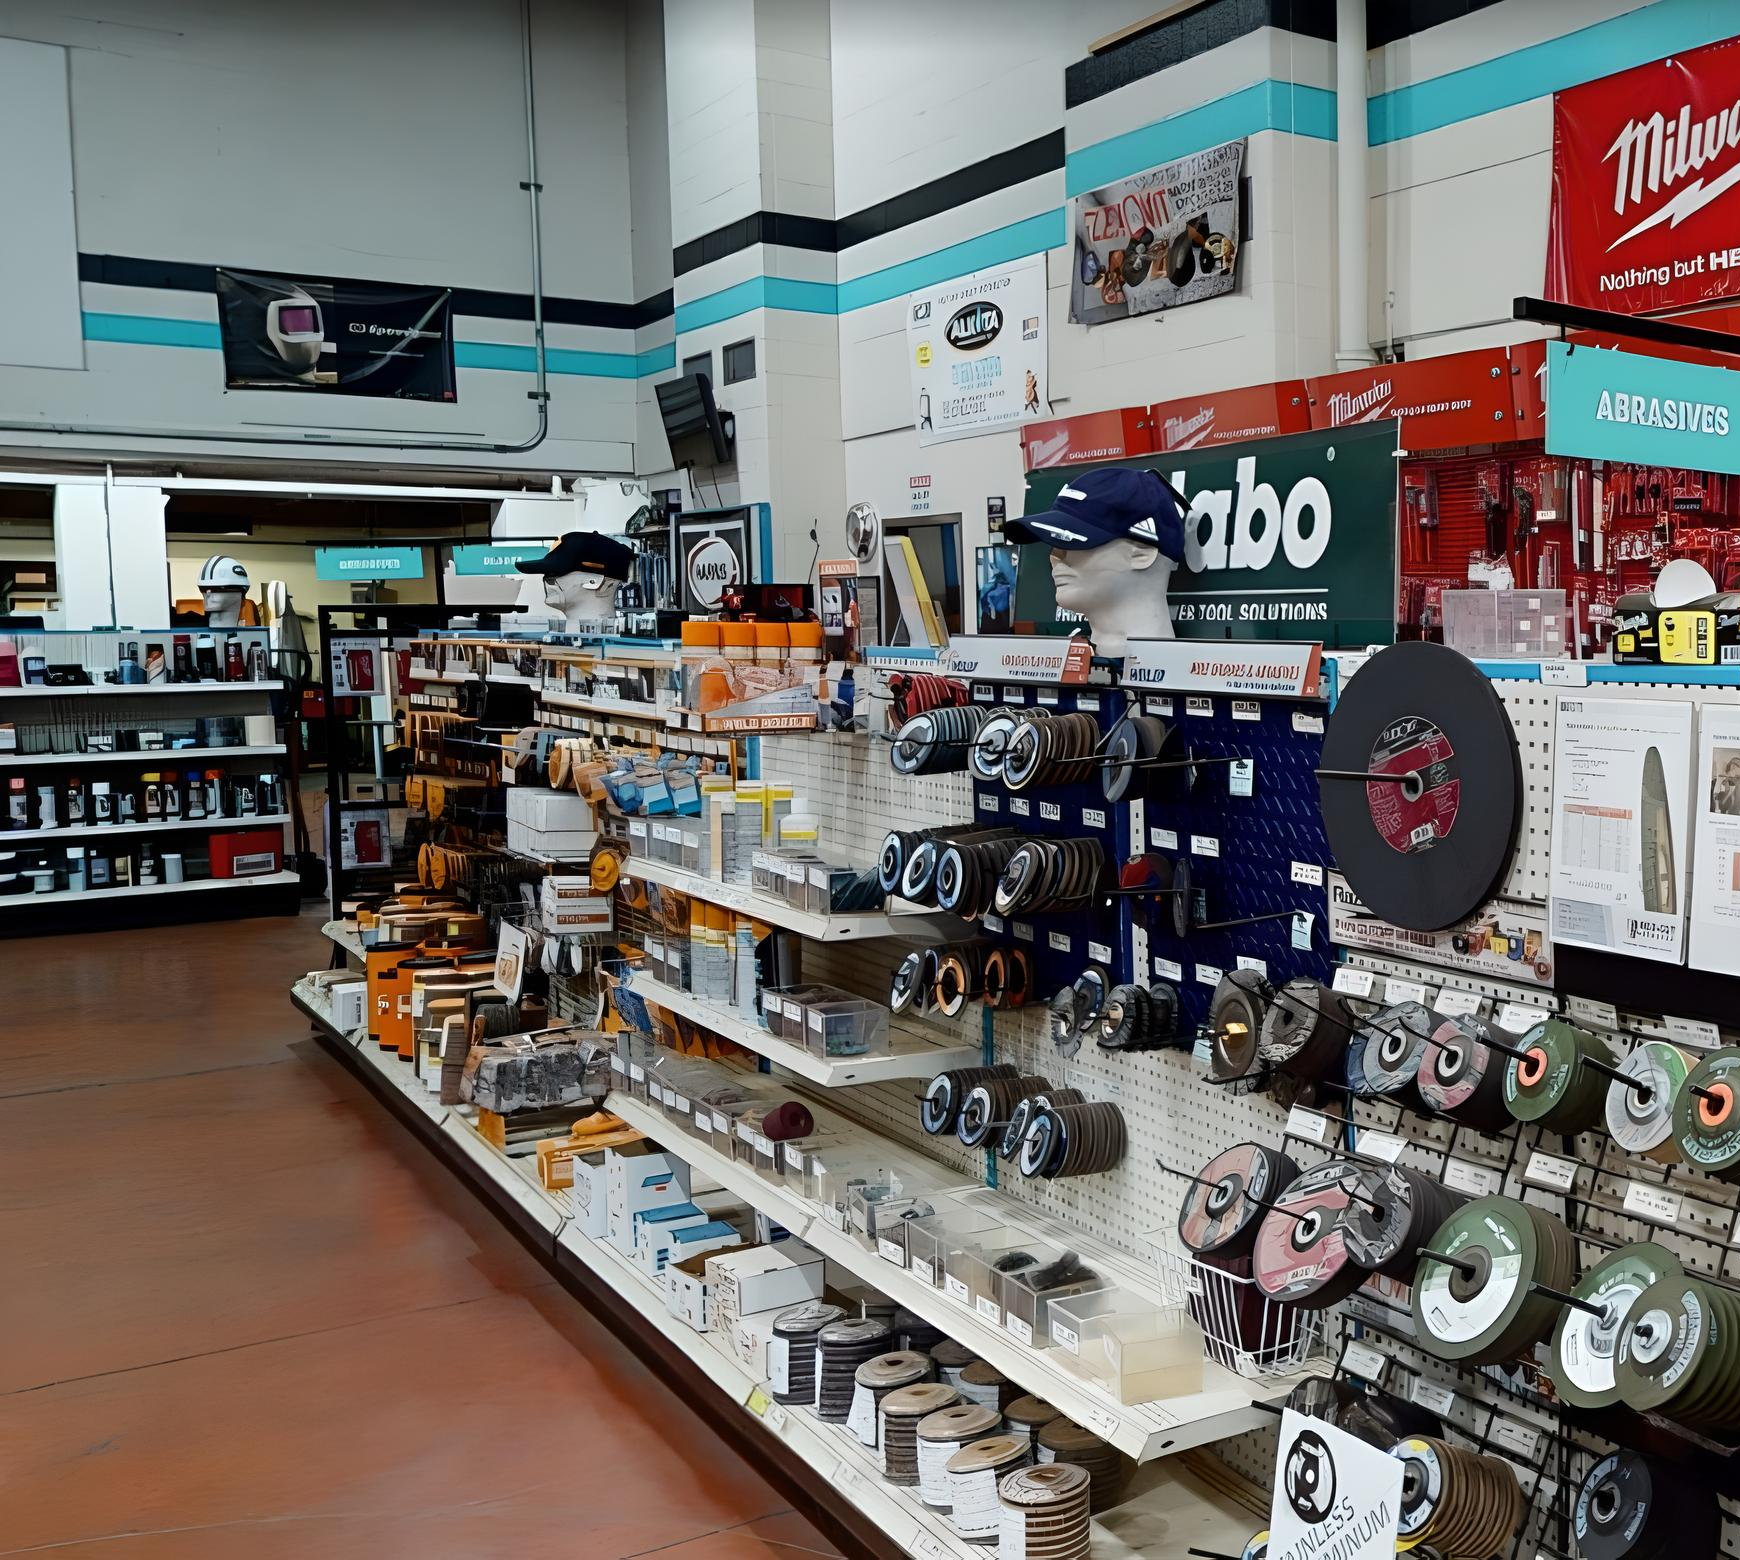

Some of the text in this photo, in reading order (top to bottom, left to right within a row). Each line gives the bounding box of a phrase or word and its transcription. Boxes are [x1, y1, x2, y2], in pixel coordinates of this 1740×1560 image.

[1600, 267, 1670, 292] Nothing
[1674, 254, 1706, 278] but
[1595, 389, 1730, 437] ABRASIVES
[1199, 603, 1234, 621] TOOL
[1239, 602, 1328, 621] SOLUTIONS
